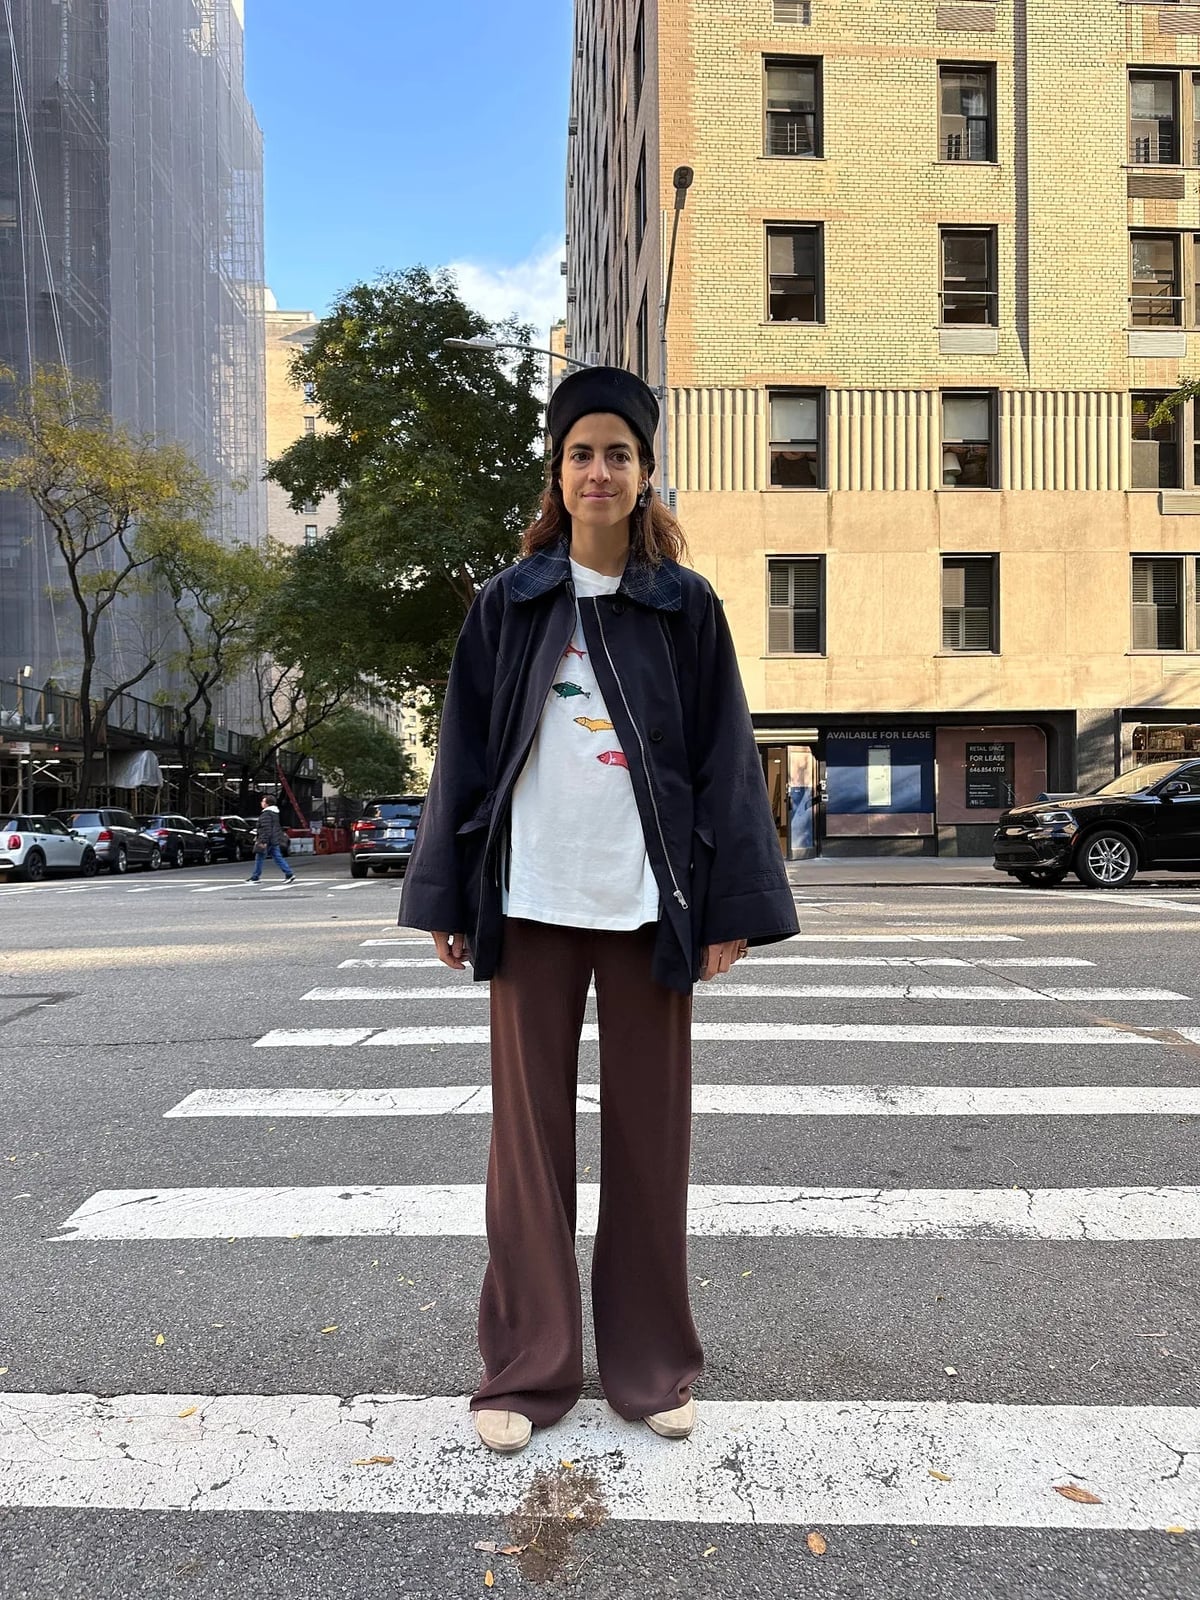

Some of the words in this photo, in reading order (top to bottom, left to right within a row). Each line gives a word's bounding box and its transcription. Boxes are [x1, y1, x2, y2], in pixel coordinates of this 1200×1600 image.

[826, 731, 878, 740] AVAILABLE
[880, 731, 899, 739] FOR
[901, 731, 931, 739] LEASE
